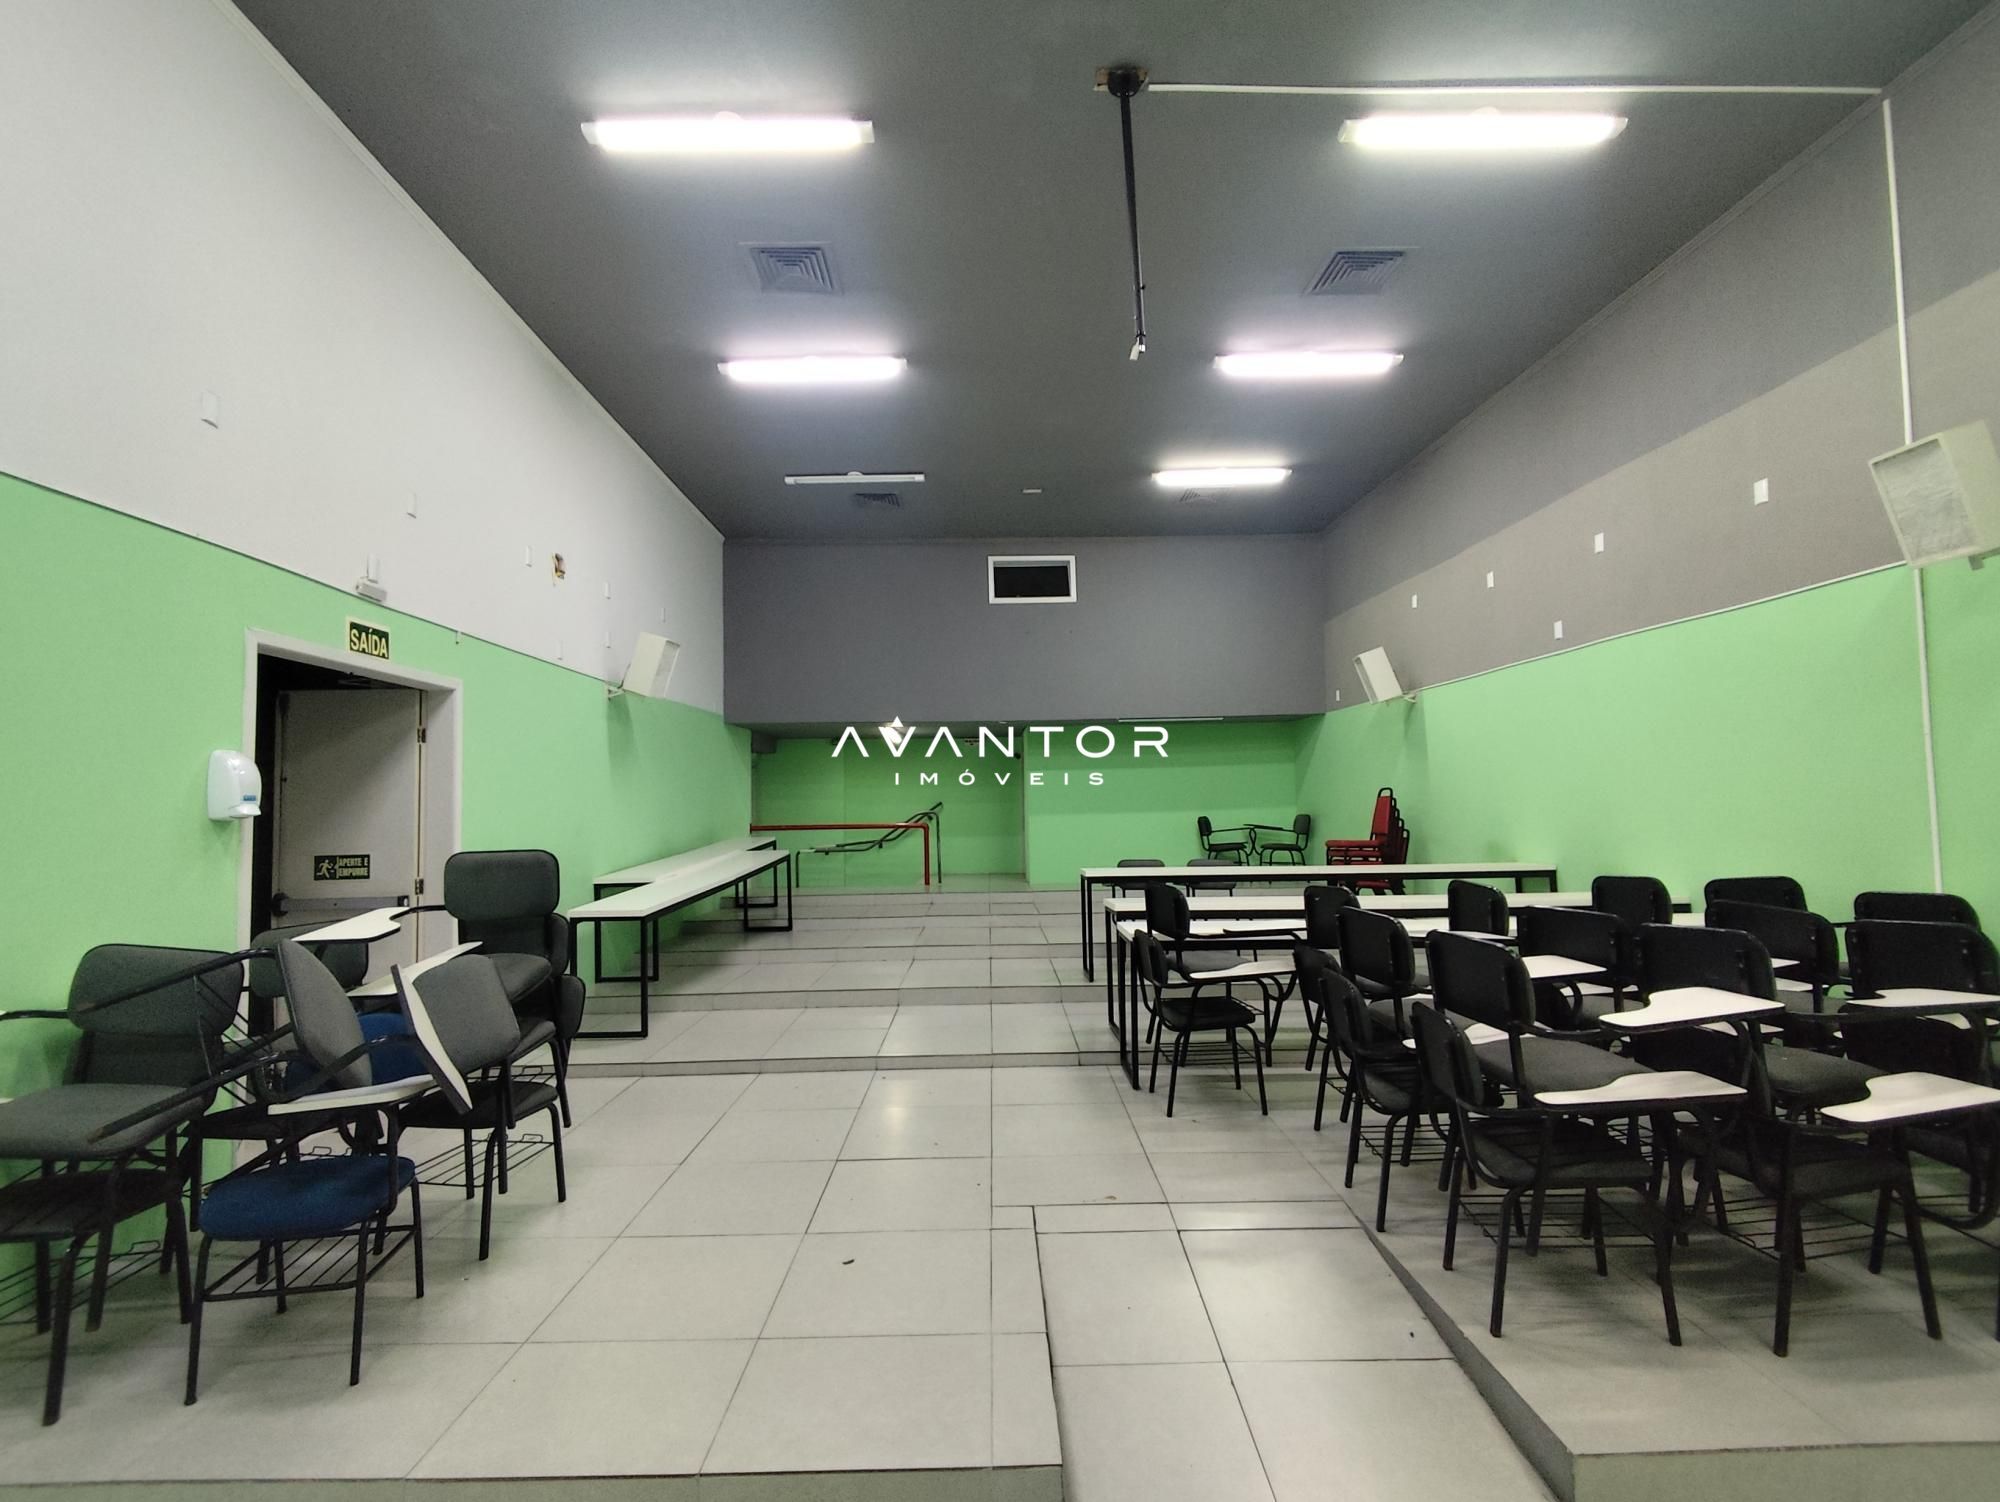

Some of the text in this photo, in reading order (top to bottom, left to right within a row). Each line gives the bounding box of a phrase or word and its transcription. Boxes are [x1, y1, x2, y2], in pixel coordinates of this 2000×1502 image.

[350, 628, 388, 658] SAÍDA
[339, 857, 369, 866] APERTE E
